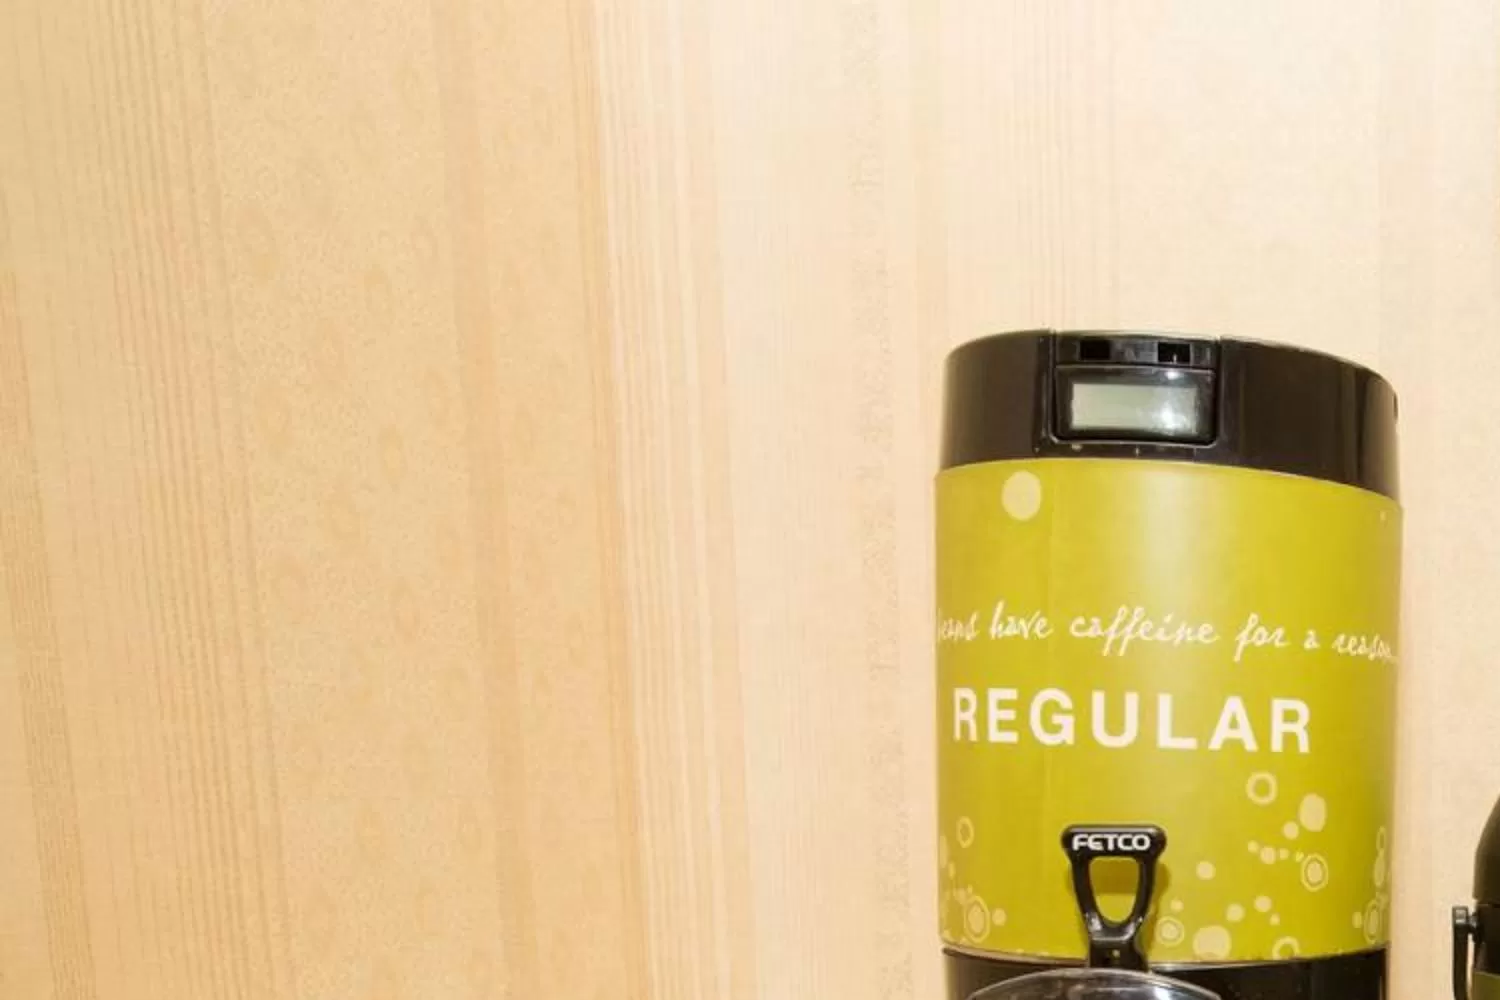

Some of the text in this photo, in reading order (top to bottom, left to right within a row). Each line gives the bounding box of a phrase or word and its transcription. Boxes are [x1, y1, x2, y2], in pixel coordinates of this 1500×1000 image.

[989, 598, 1054, 640] have
[1069, 604, 1219, 657] caffeine
[1233, 612, 1290, 662] for
[1303, 629, 1320, 650] a
[953, 687, 1311, 753] REGULAR
[1071, 832, 1151, 851] FETCO
